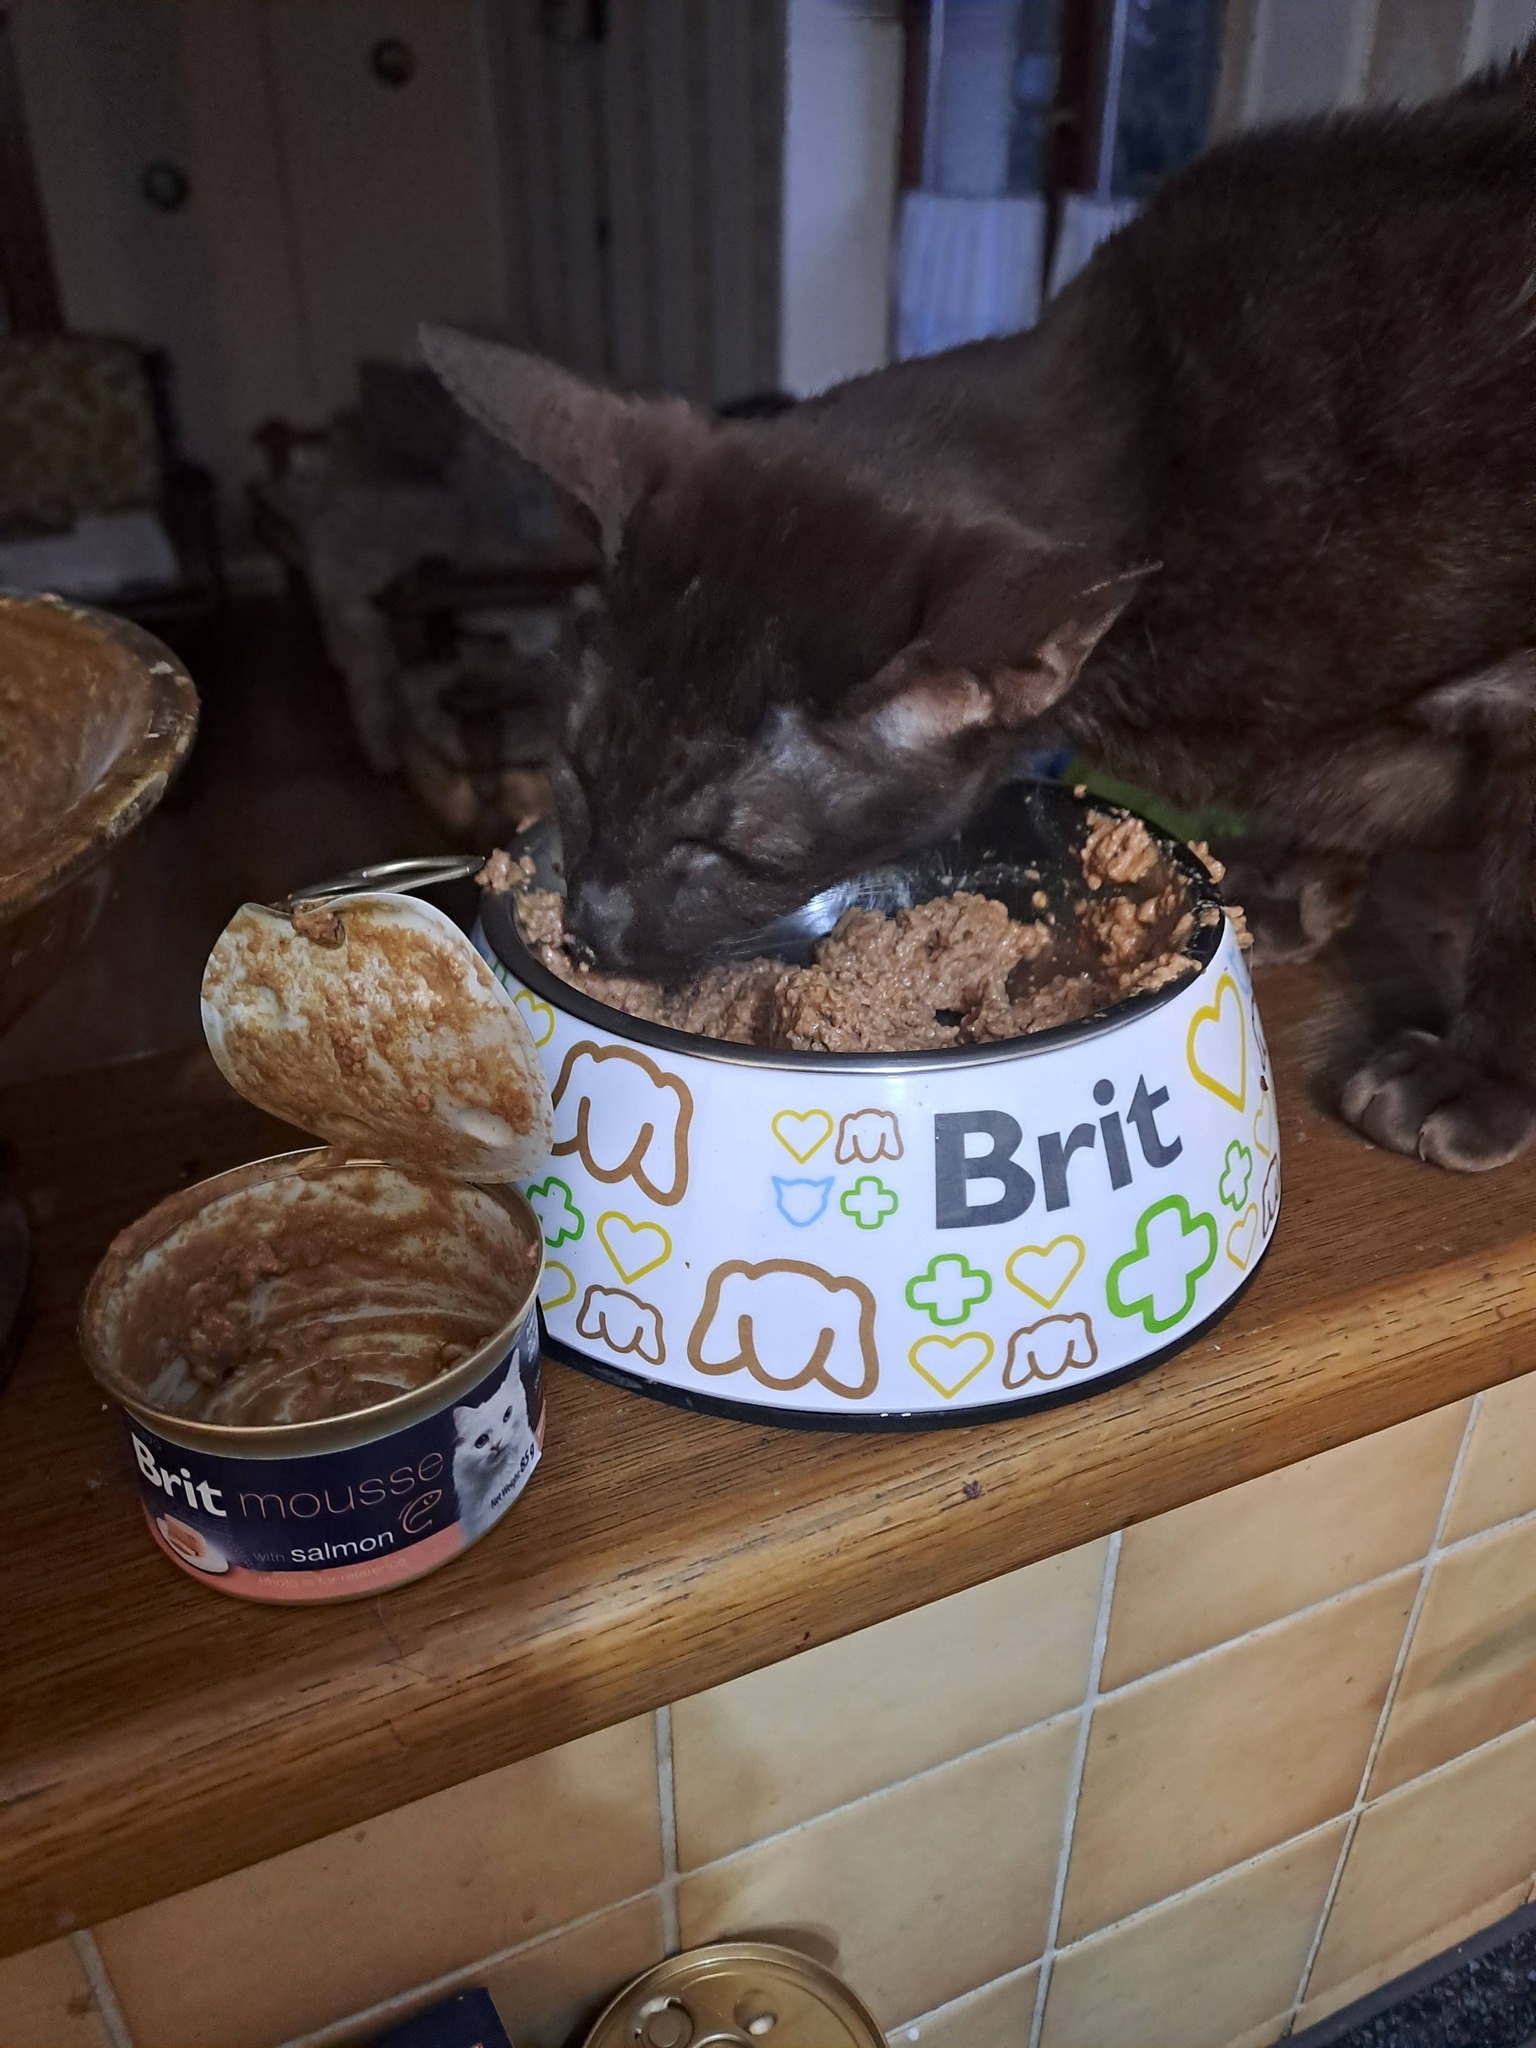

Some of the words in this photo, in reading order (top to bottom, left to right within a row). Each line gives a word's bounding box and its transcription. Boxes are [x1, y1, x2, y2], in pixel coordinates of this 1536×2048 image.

[934, 1074, 1183, 1229] Brit
[131, 1432, 227, 1517] Brit
[240, 1453, 443, 1518] mousse
[253, 1552, 285, 1562] with
[291, 1531, 394, 1562] salmon
